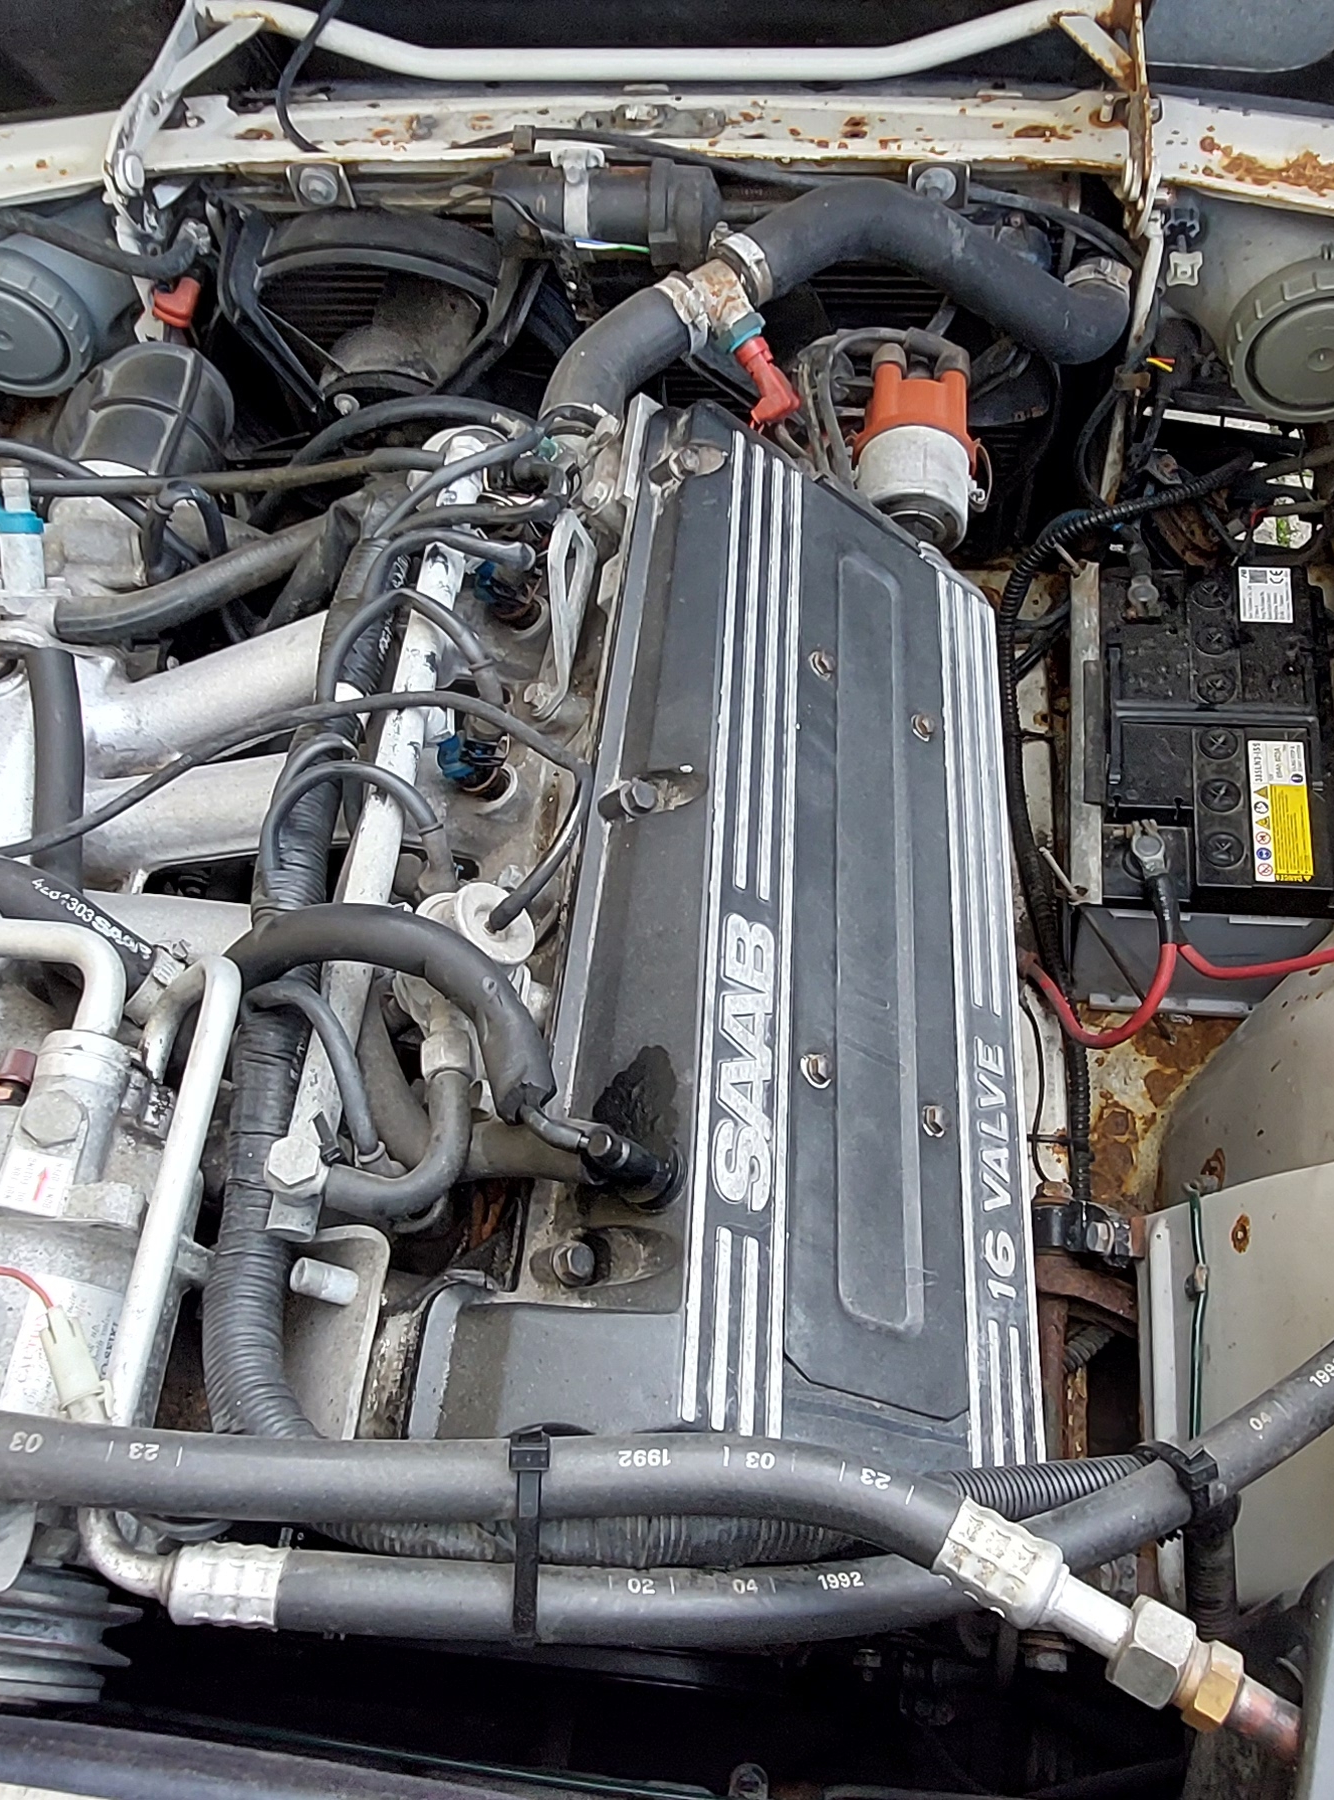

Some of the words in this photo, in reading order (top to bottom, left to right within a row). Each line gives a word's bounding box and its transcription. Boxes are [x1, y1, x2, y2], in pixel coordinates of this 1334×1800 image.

[712, 912, 777, 1211] SAAB
[972, 1036, 1011, 1214] VALVE
[985, 1229, 1018, 1301] 16
[9, 1432, 43, 1454] 03
[128, 1441, 159, 1460] 23
[618, 1448, 672, 1468] 1992
[745, 1451, 776, 1471] 03
[860, 1467, 892, 1491] 23
[627, 1578, 657, 1595] 02
[732, 1578, 759, 1595] 04
[817, 1570, 865, 1592] 1992
